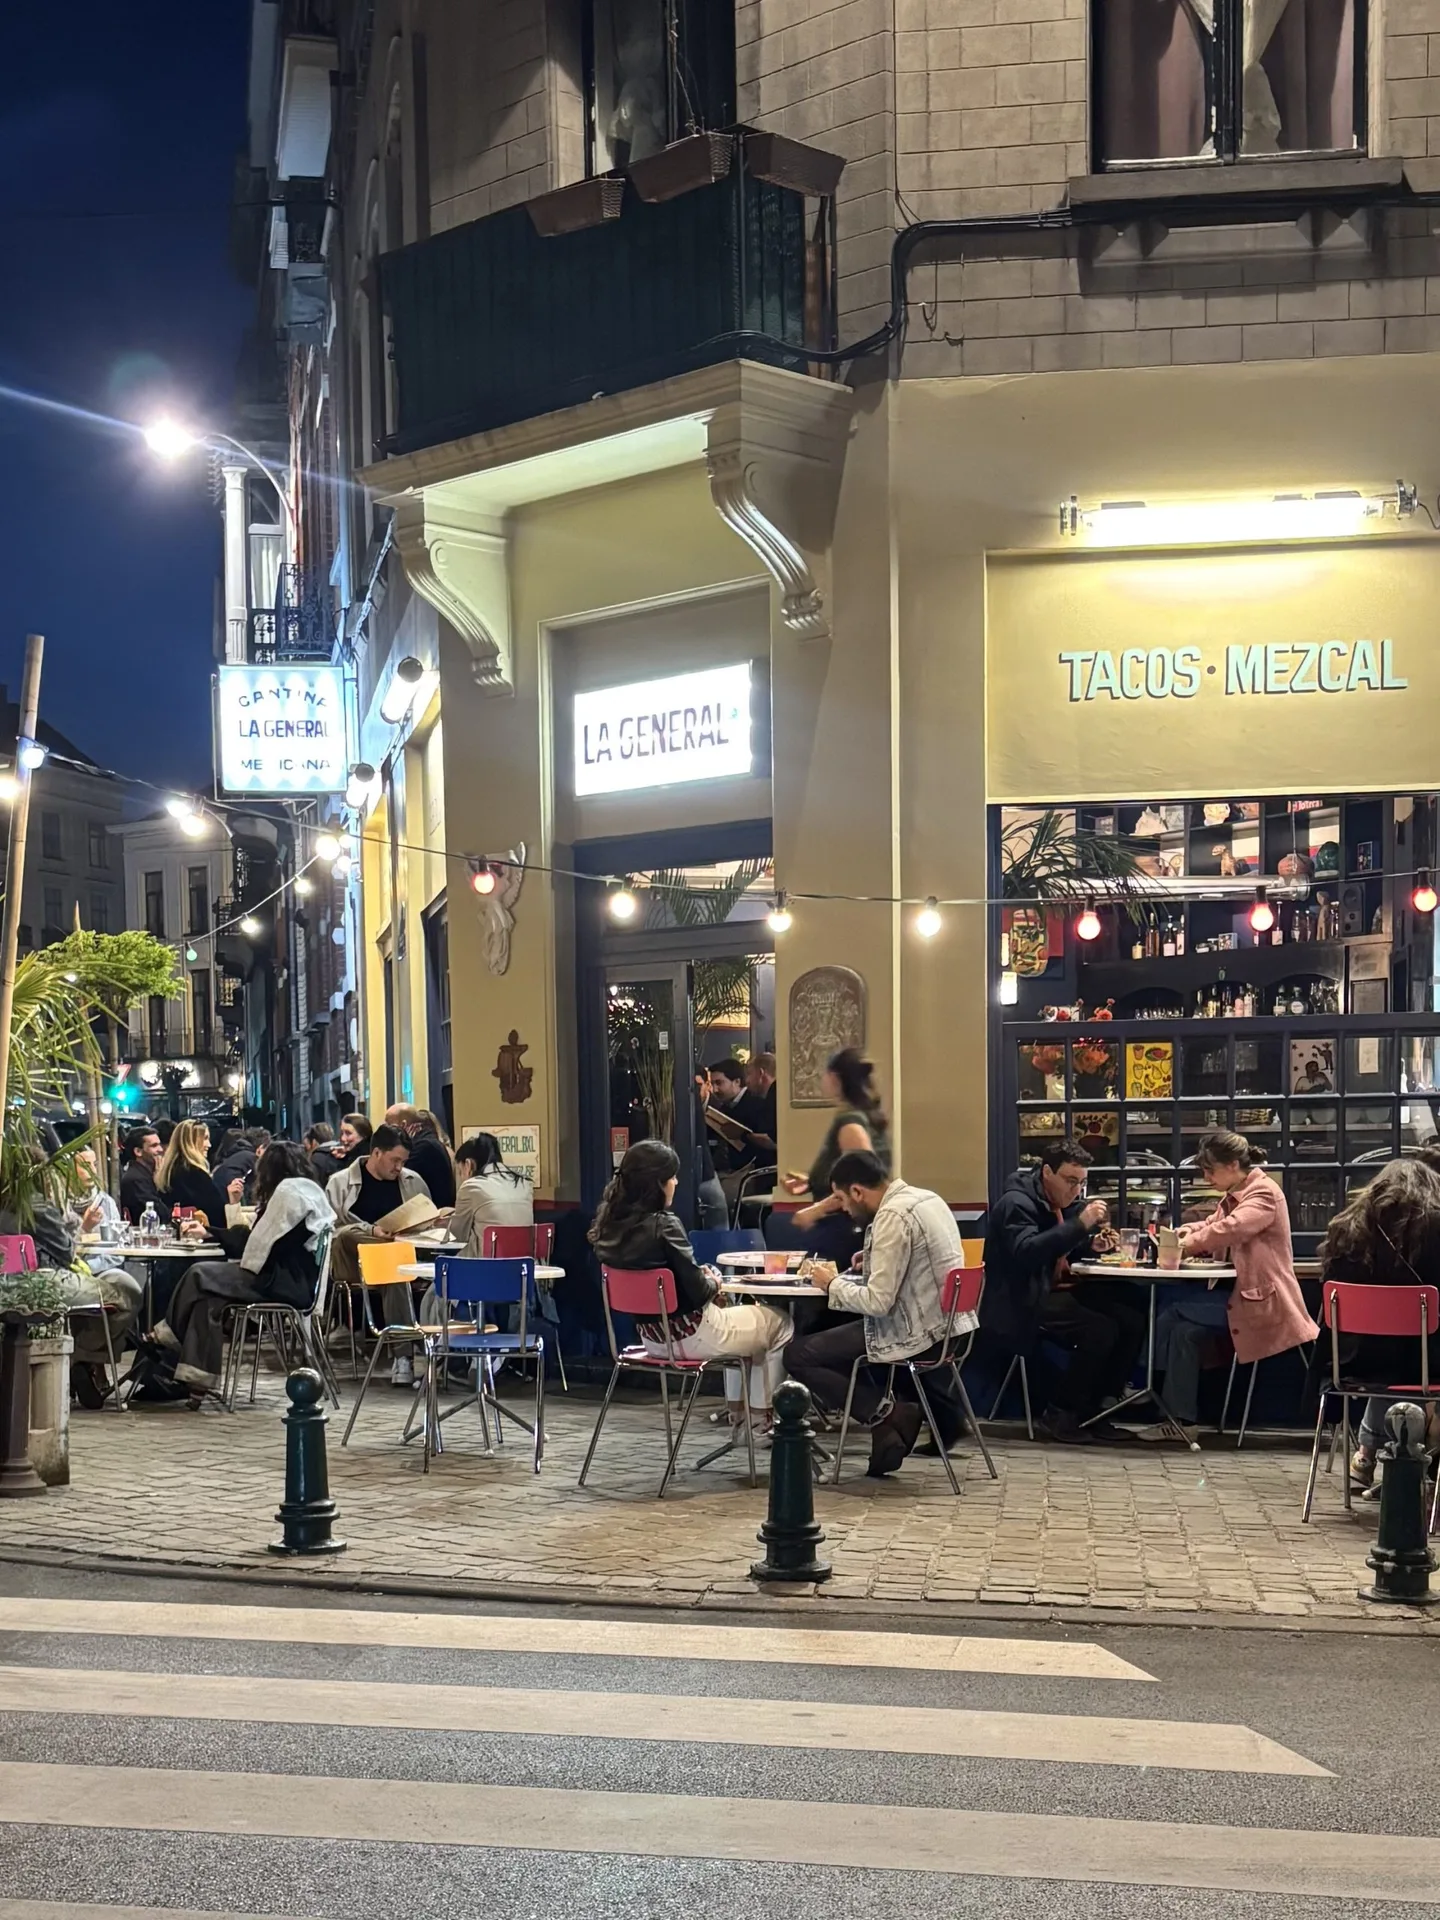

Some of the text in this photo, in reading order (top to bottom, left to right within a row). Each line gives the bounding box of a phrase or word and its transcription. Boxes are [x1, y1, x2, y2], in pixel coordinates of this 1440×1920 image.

[1059, 639, 1409, 702] TACOS MEZCAL
[238, 719, 329, 738] LA GENERAL
[584, 703, 729, 764] LA GENERAL
[240, 759, 331, 770] MEICNA
